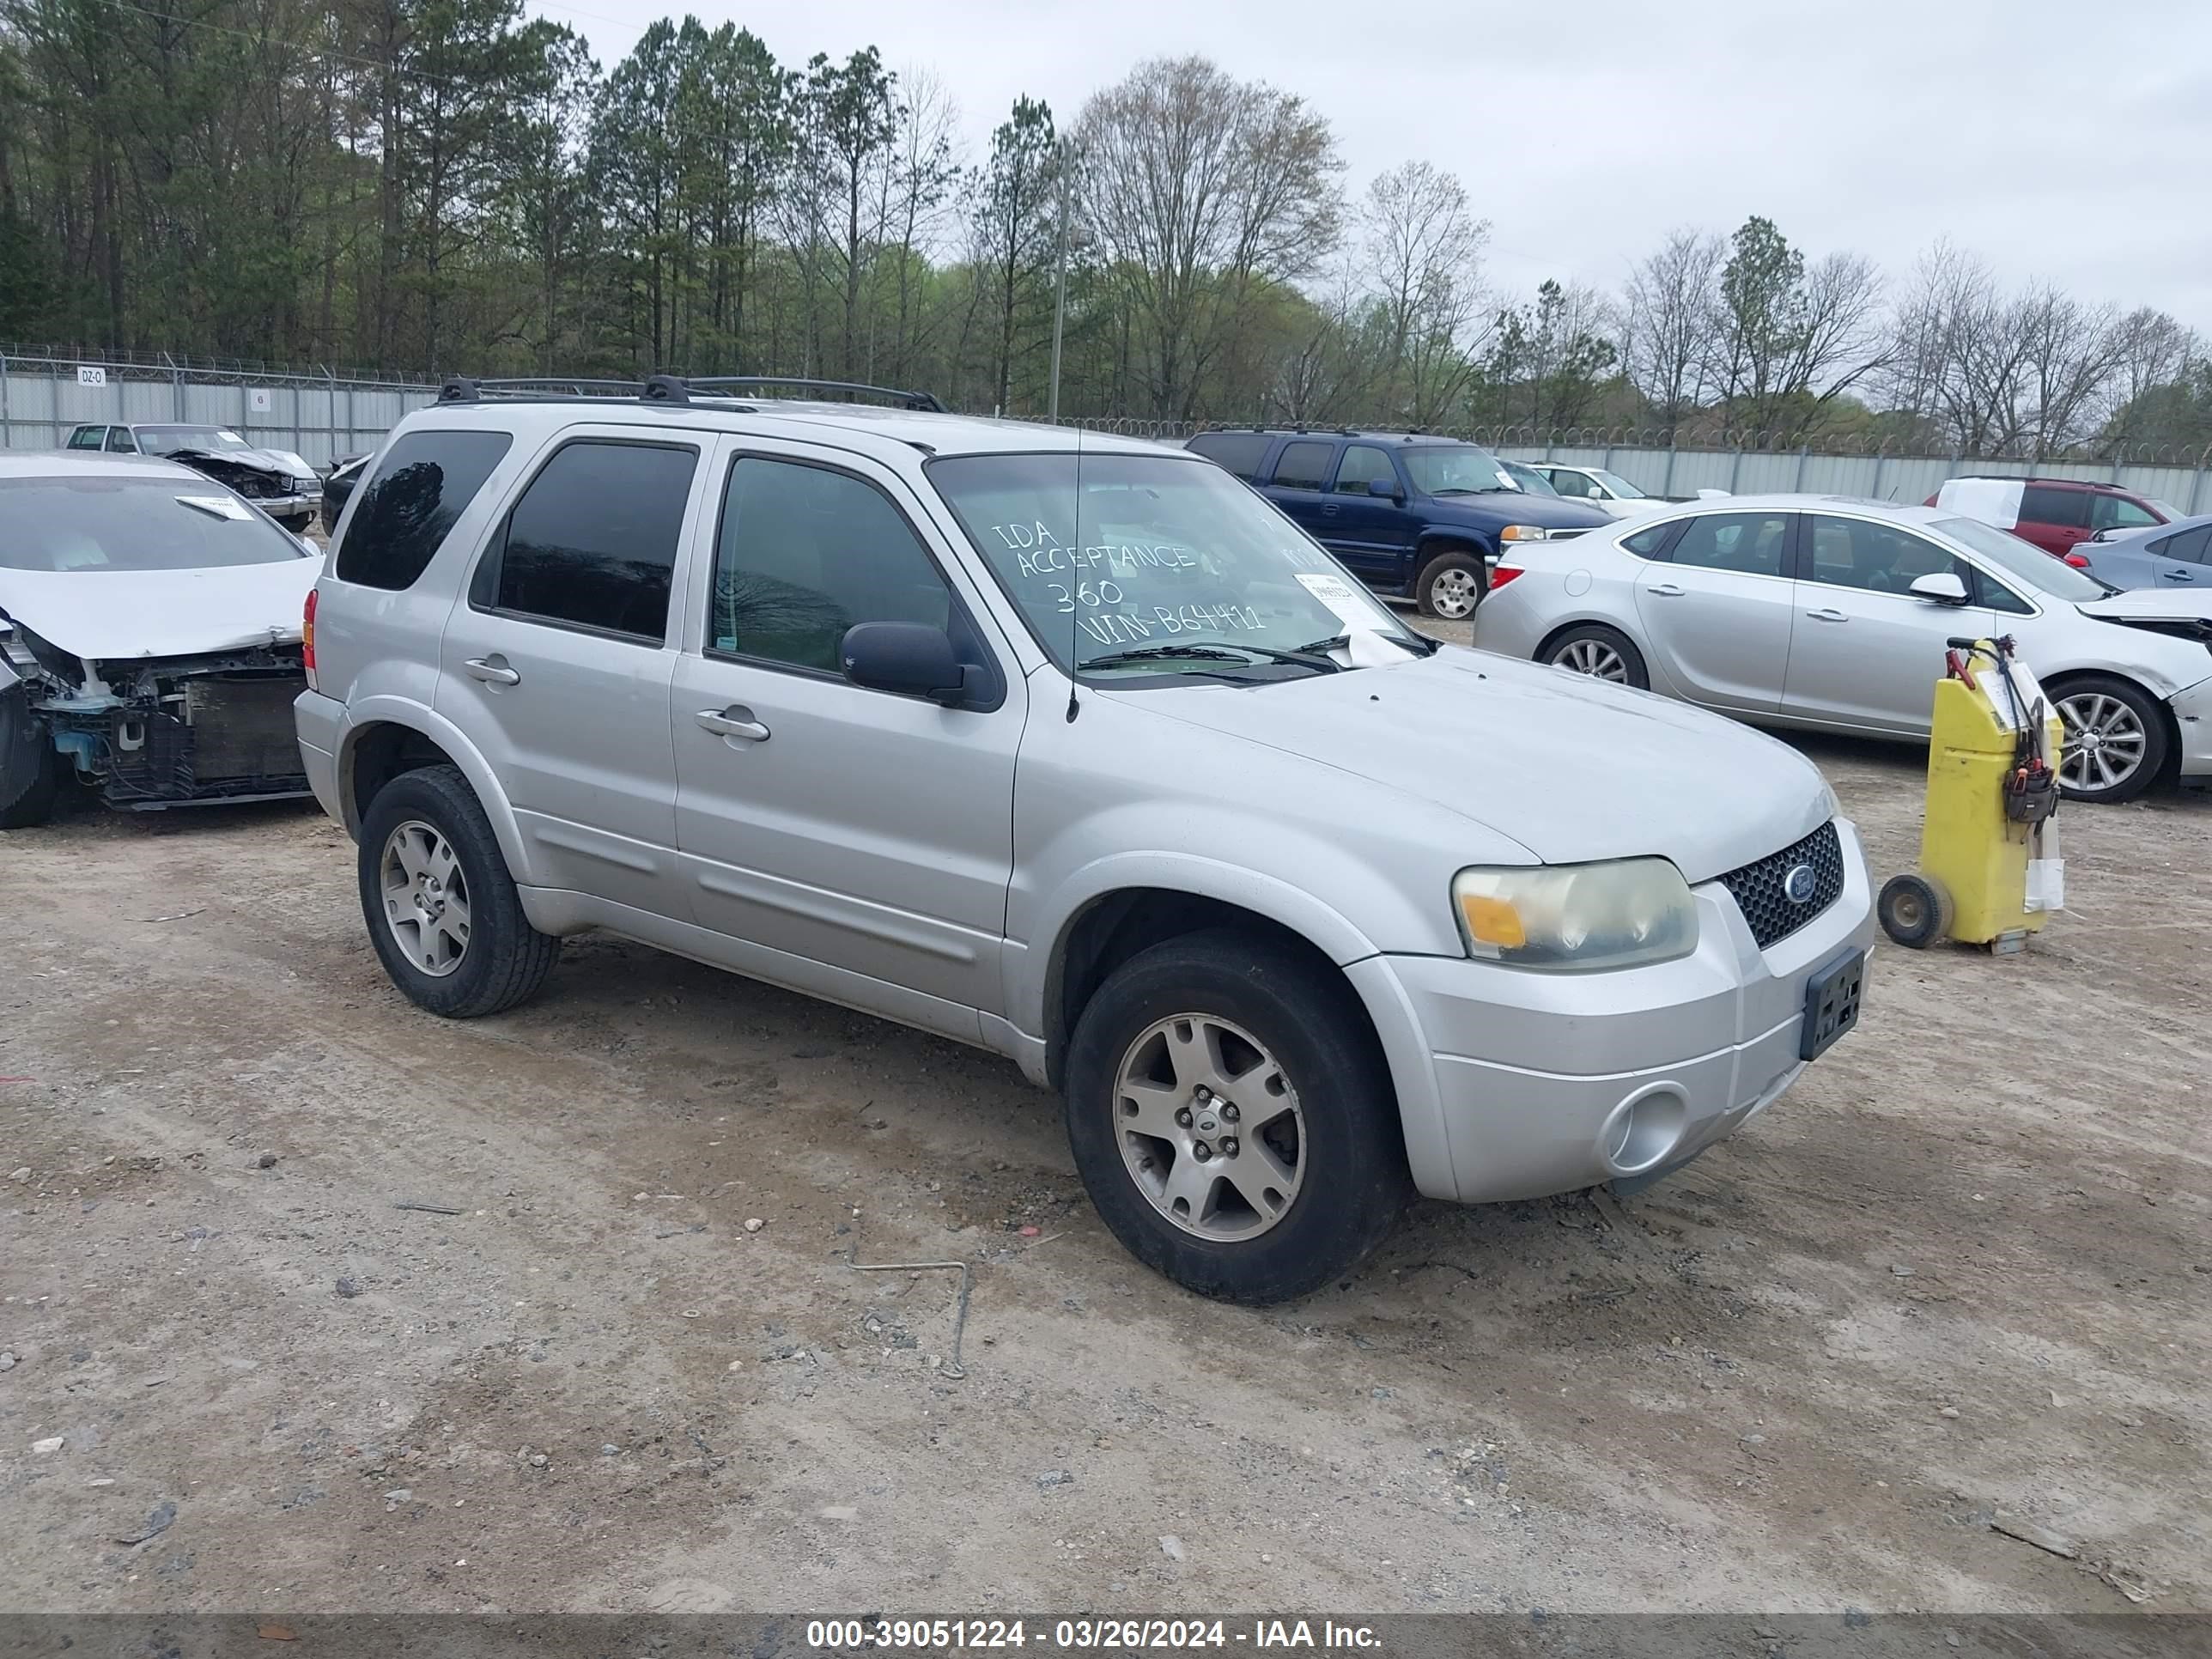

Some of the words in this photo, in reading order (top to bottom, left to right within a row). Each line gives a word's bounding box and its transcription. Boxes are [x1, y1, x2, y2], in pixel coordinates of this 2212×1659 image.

[257, 395, 264, 404] 6
[991, 520, 1059, 550] IDA
[1017, 545, 1196, 578] ACCEPTANCE
[1047, 580, 1123, 613] 360
[1076, 604, 1267, 646] VIN-B64411
